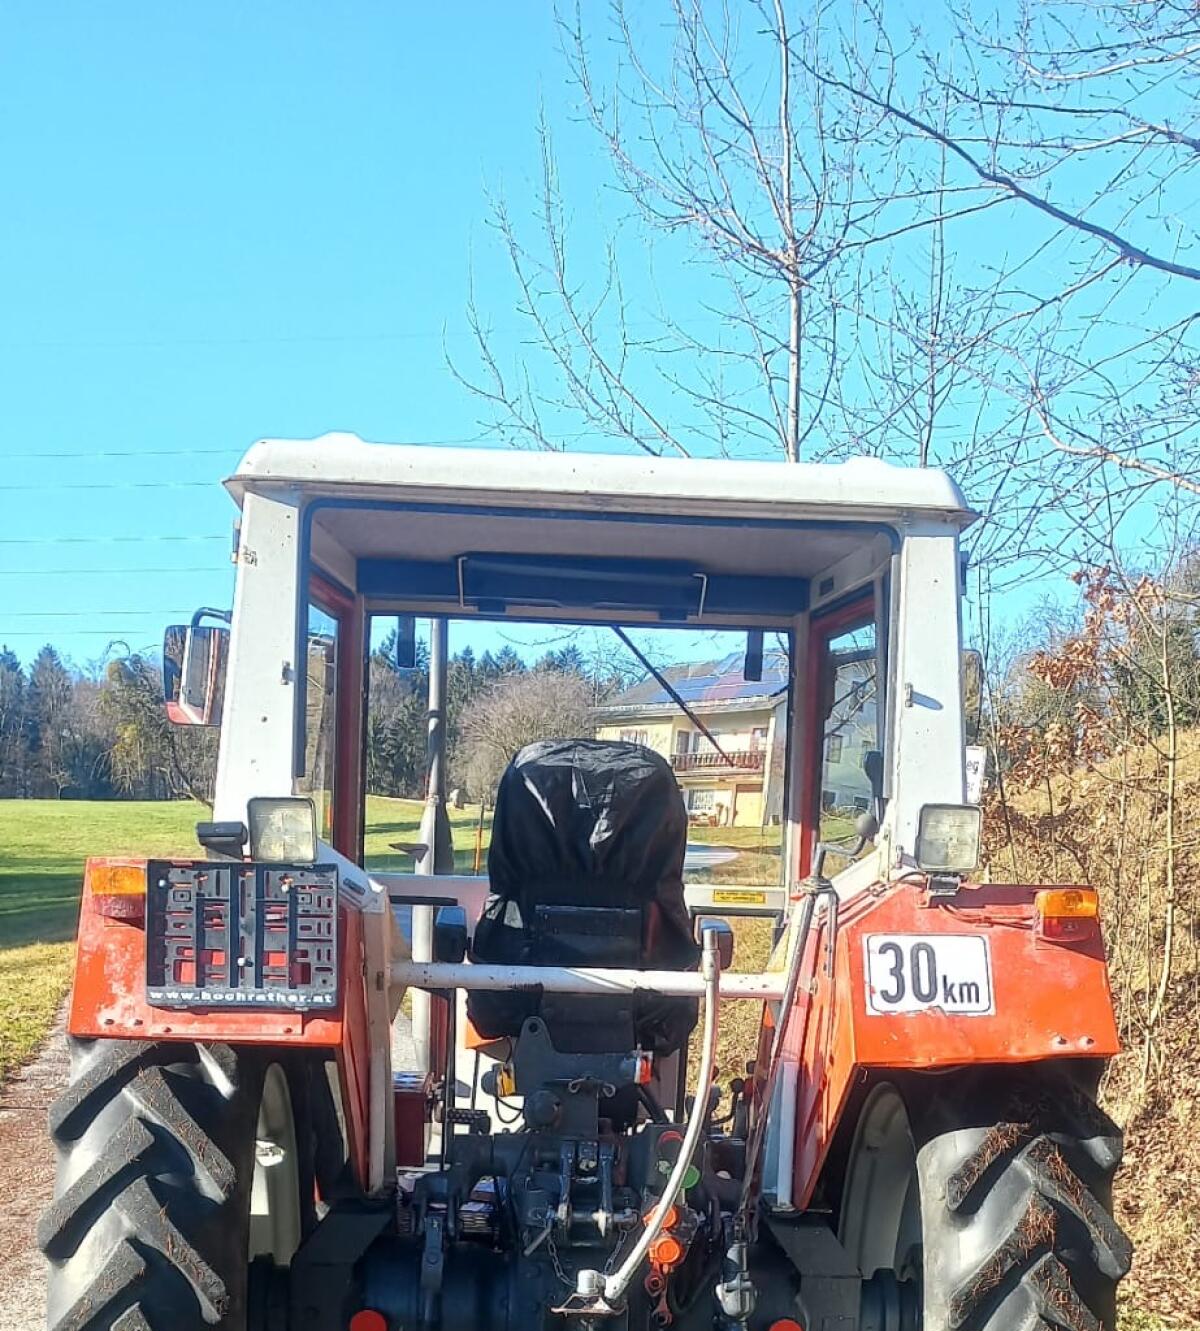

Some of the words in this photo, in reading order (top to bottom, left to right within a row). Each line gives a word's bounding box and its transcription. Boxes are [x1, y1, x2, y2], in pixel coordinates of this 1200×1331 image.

[878, 942, 938, 1003] 30
[942, 974, 979, 1003] km
[150, 991, 332, 1003] www.hochrather.at
